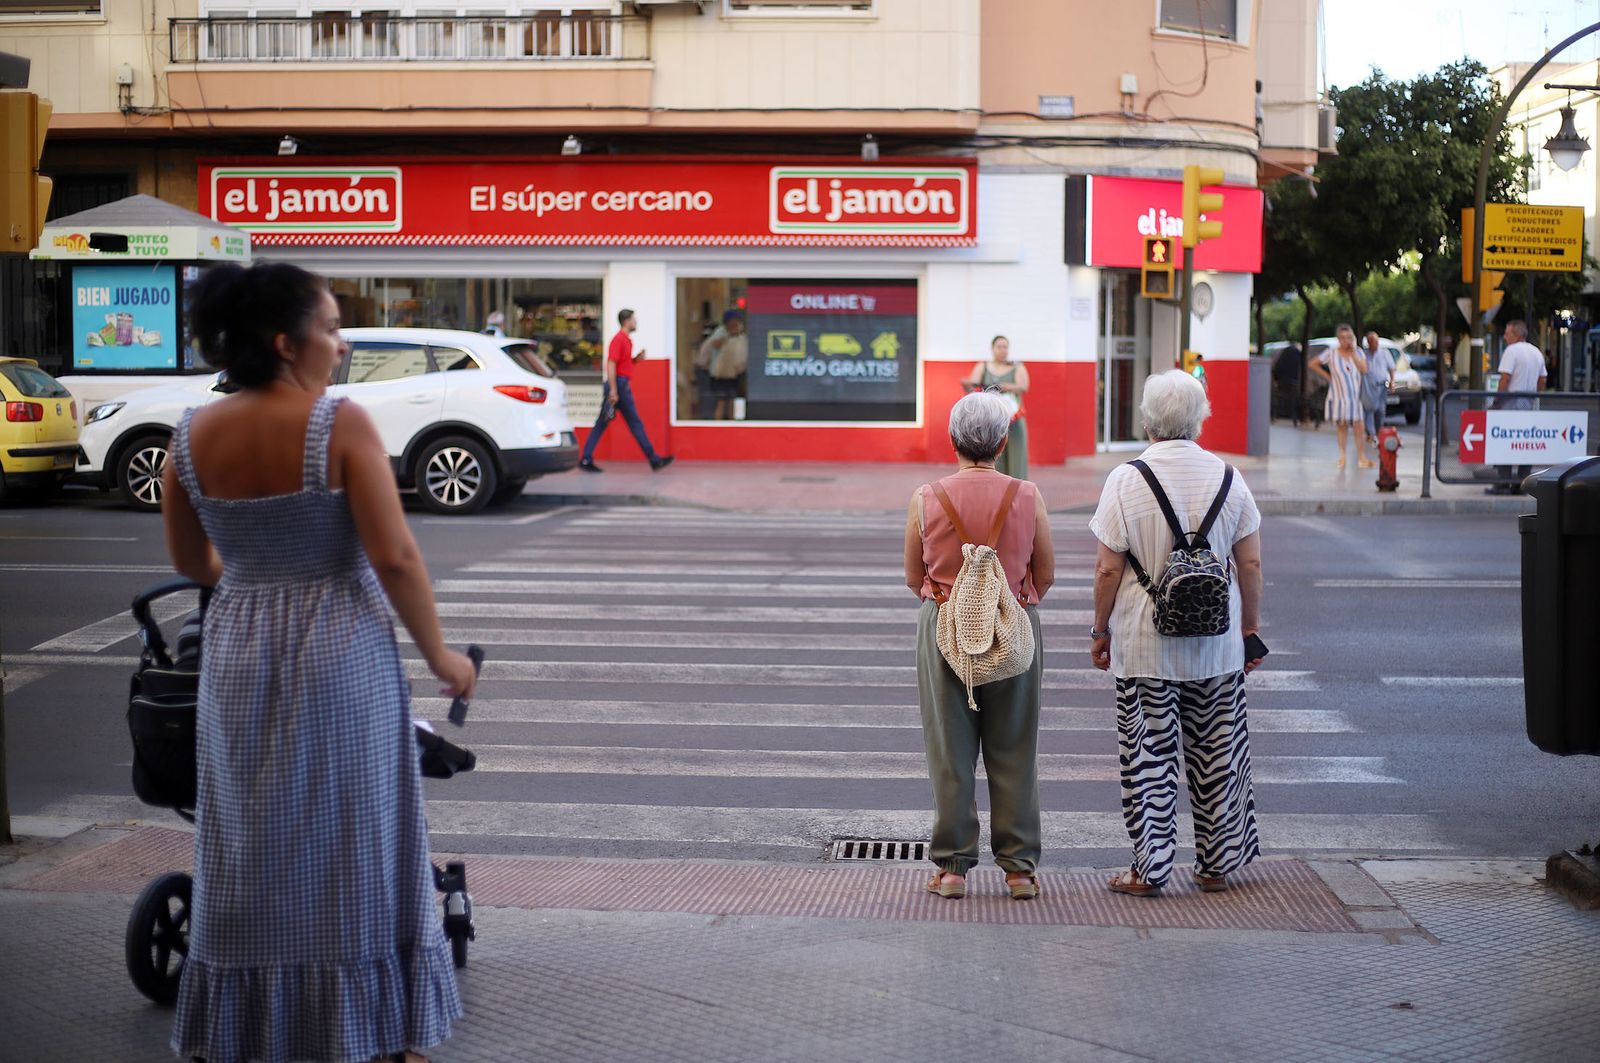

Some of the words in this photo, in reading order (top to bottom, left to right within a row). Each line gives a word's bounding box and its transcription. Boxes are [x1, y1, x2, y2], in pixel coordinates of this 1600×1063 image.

[224, 179, 259, 213] el
[265, 175, 389, 221] jamón
[470, 185, 496, 211] El
[502, 184, 587, 217] súper
[591, 190, 713, 211] cercano
[783, 178, 821, 214] el
[825, 176, 955, 222] jamón
[1505, 208, 1564, 216] PSICOTECNICOS
[1507, 217, 1561, 225] CONDUCTORES
[127, 234, 169, 244] ORTEO
[1488, 235, 1541, 244] CERTIFICADOS
[134, 246, 169, 256] TUYO
[77, 287, 110, 306] BIEN
[113, 287, 170, 305] JUGADO
[791, 294, 858, 309] ONLINE
[828, 360, 899, 376] GRATIS!
[1491, 426, 1558, 439] Carrefour
[1511, 442, 1546, 450] HUELVA
